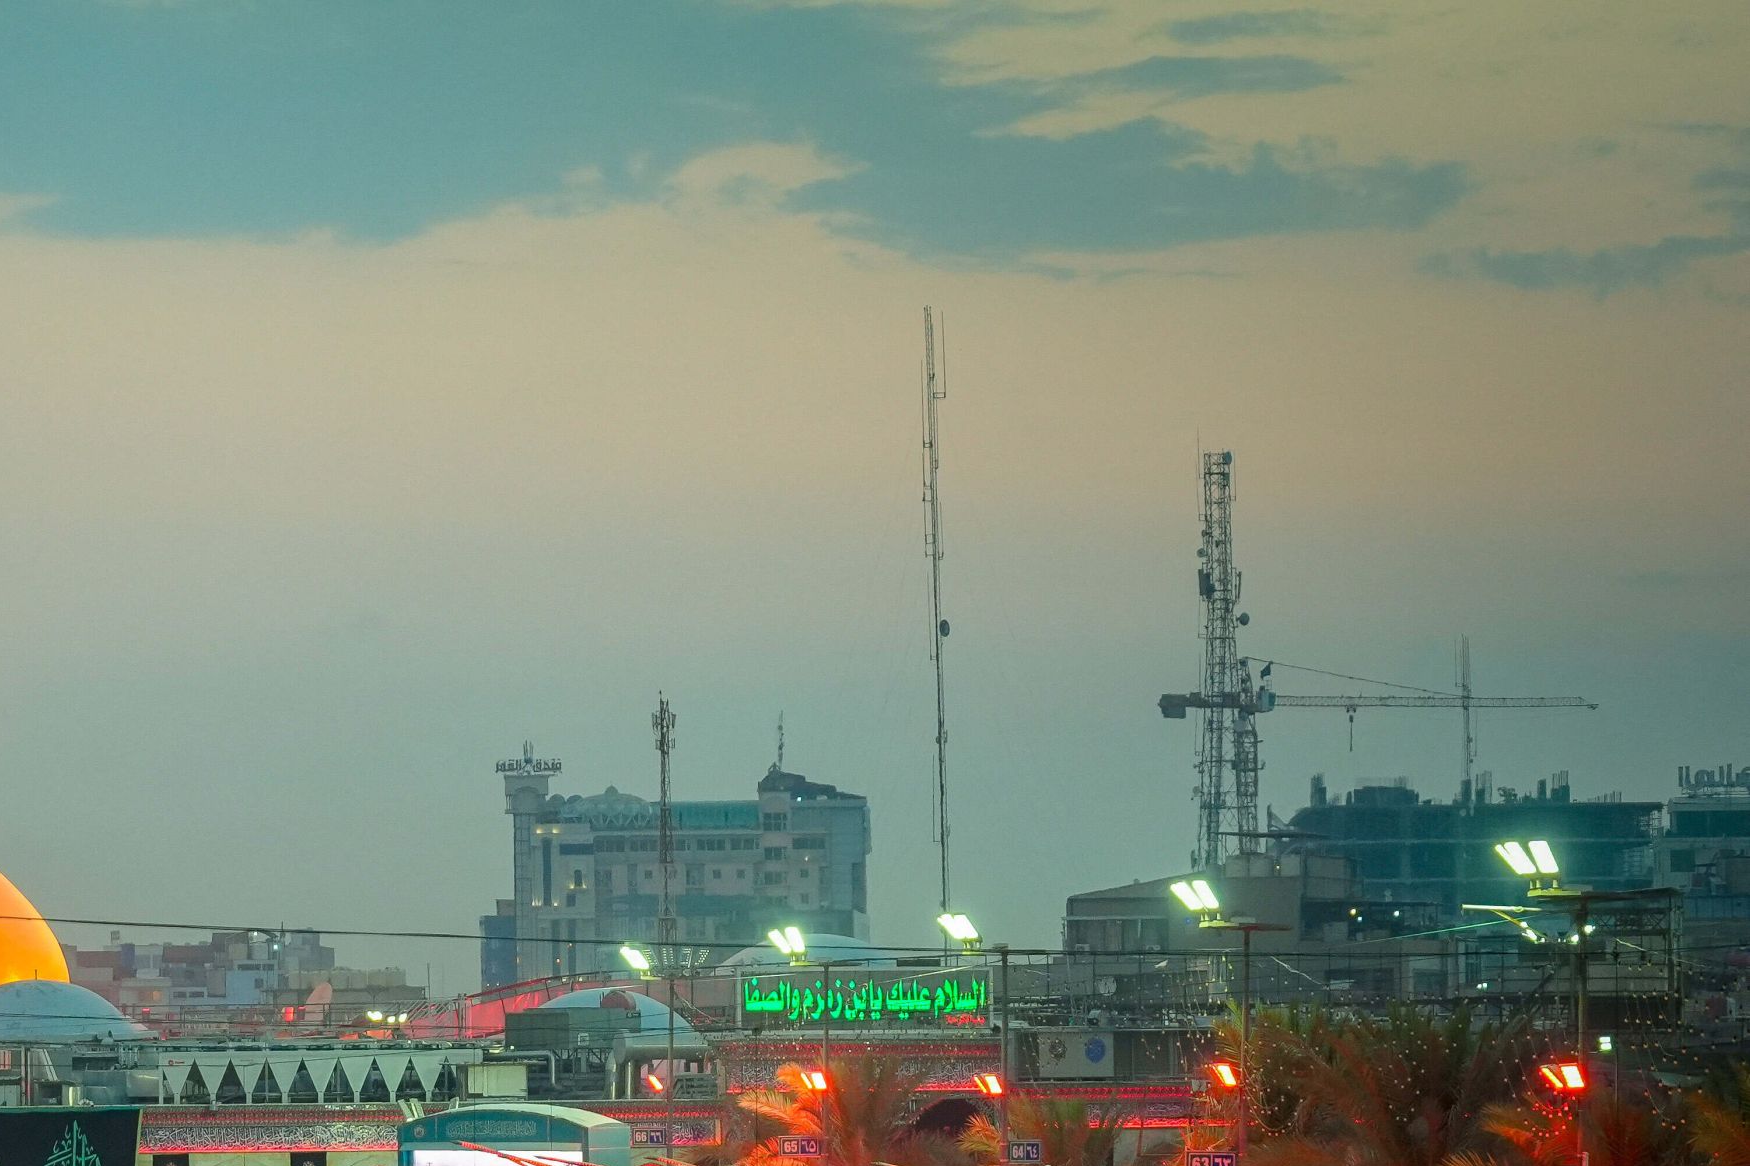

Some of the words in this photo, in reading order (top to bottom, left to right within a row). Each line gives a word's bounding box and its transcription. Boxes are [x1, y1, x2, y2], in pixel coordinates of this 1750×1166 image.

[885, 979, 933, 1020] عليك
[934, 978, 986, 1018] السلام
[635, 1132, 647, 1143] 66
[784, 1140, 798, 1153] 65
[1012, 1146, 1025, 1158] 64
